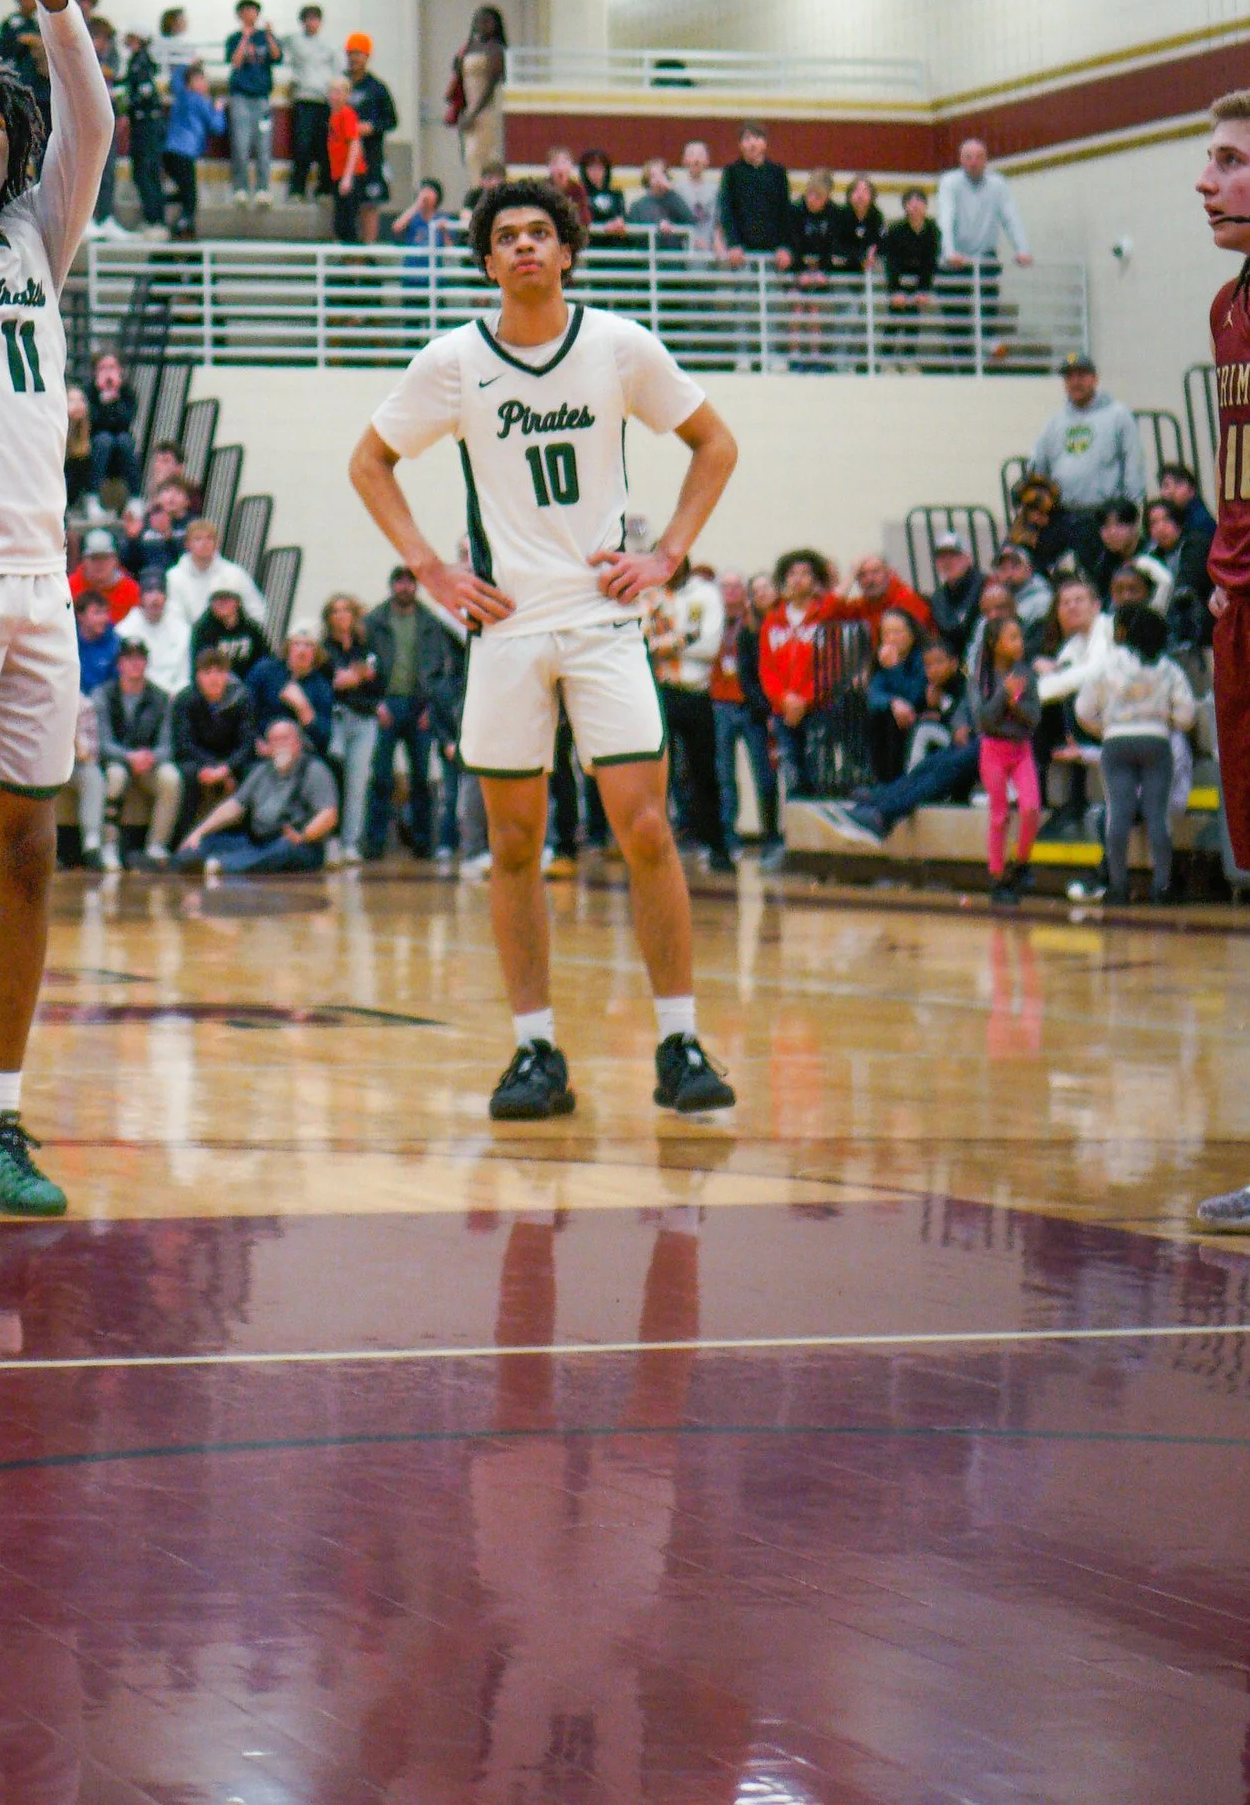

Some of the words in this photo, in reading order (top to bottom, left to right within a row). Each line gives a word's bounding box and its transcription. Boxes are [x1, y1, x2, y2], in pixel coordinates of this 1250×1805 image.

[0, 318, 47, 393] 11
[1216, 362, 1250, 408] RIM
[496, 399, 596, 440] Pirates
[525, 442, 580, 507] 10
